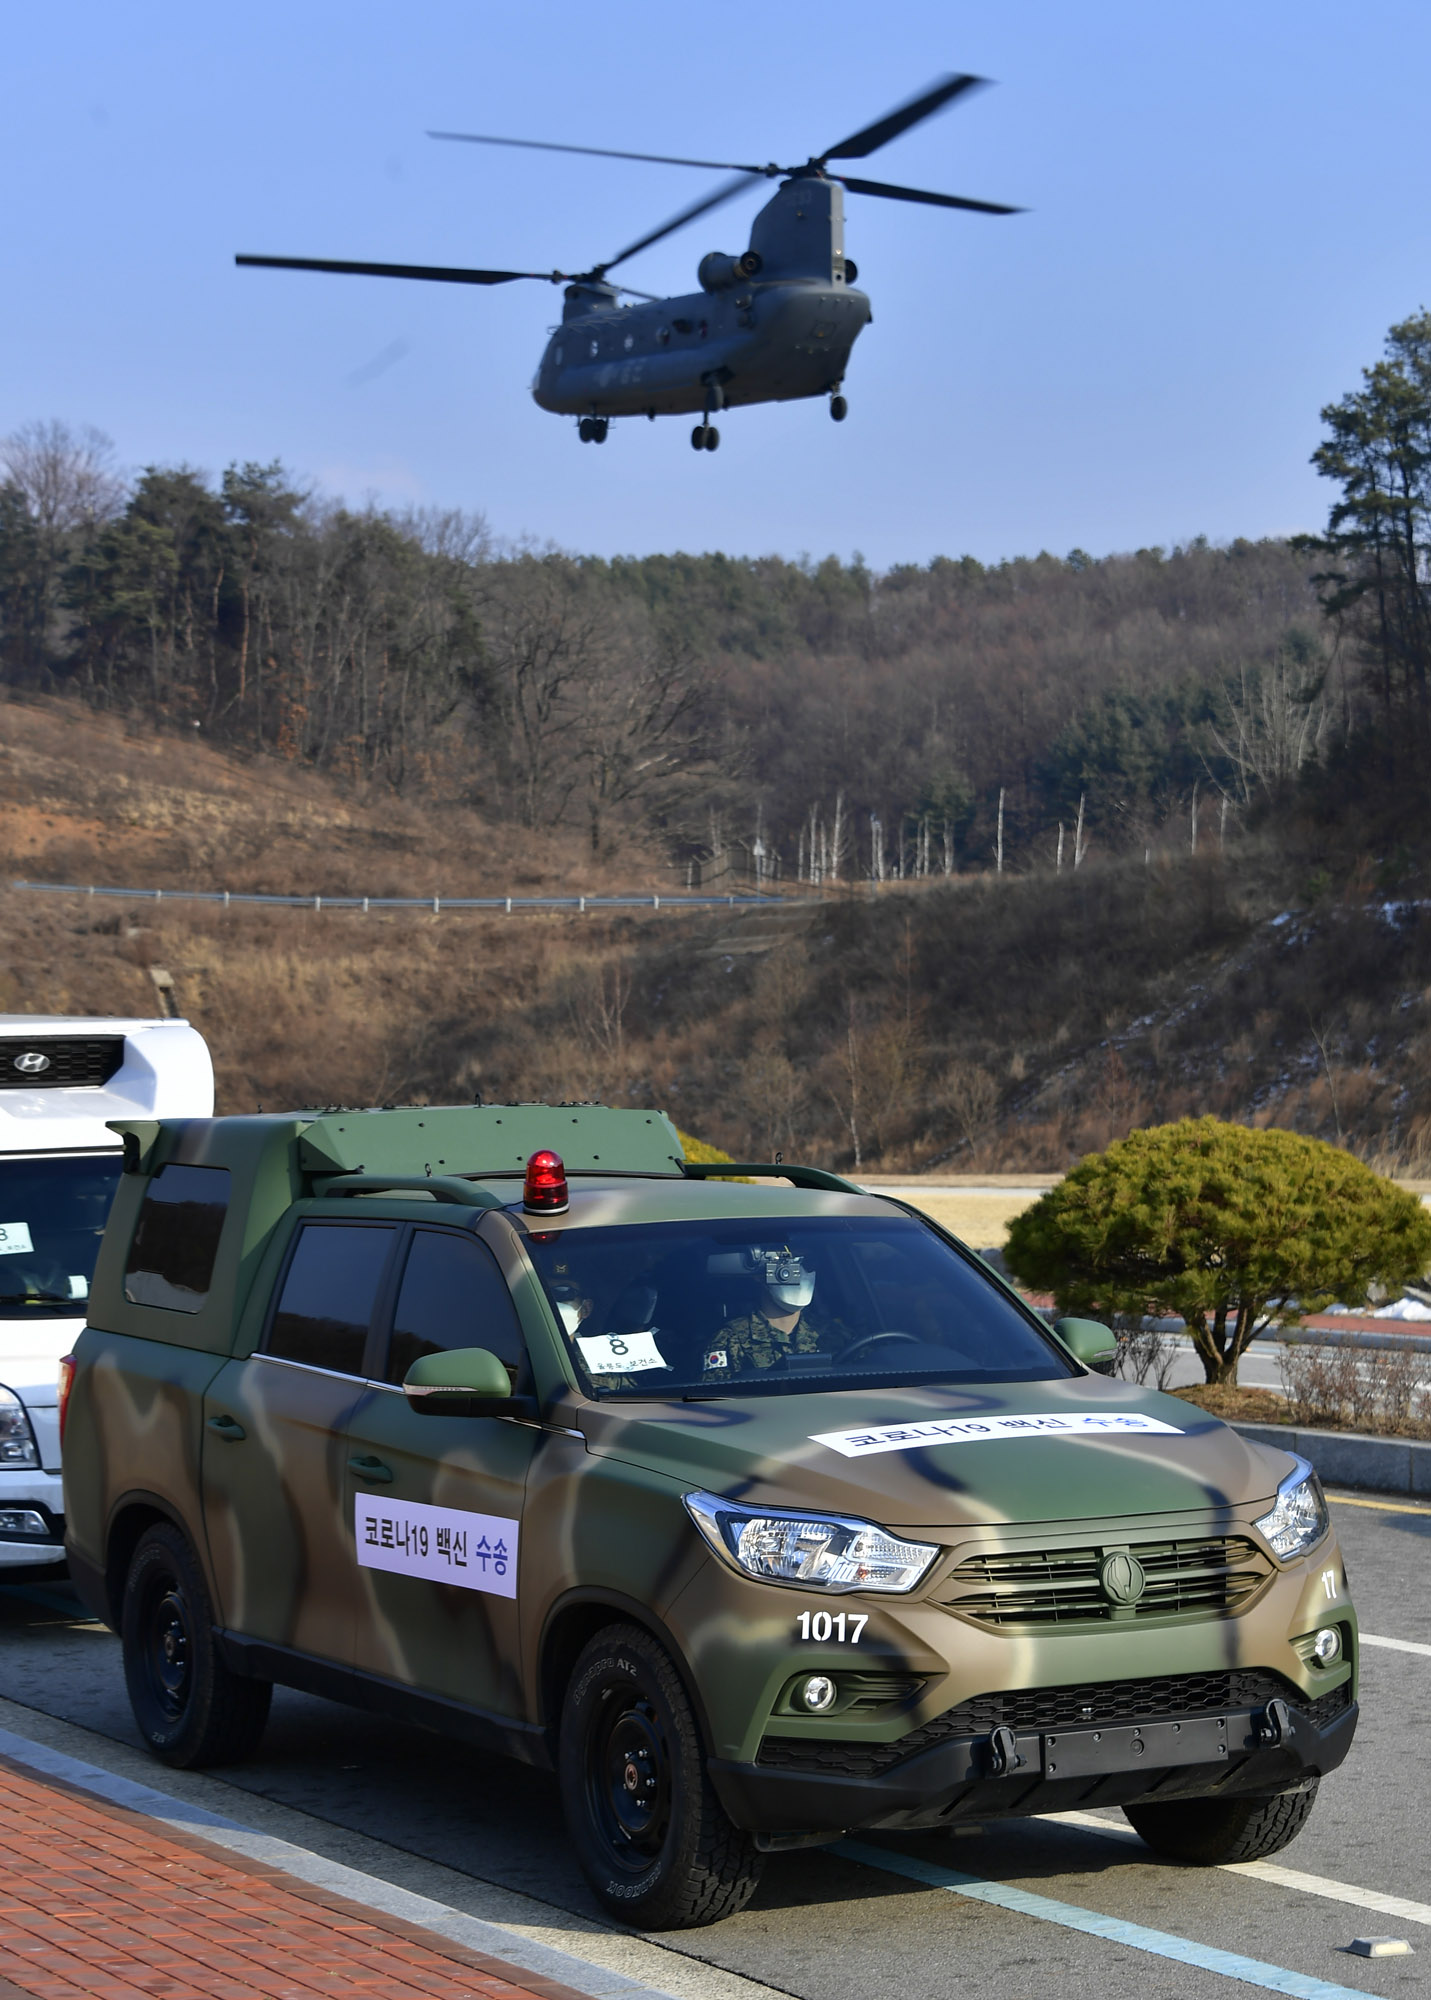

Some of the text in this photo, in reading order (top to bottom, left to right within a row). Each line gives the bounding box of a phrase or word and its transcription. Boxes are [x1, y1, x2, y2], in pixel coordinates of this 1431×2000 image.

[609, 1339, 629, 1355] 8
[845, 1417, 1148, 1447] 코로나19 백신 수송
[365, 1516, 508, 1576] 코로나19 백신 수송
[796, 1611, 869, 1644] 1017
[616, 1658, 638, 1677] AT2
